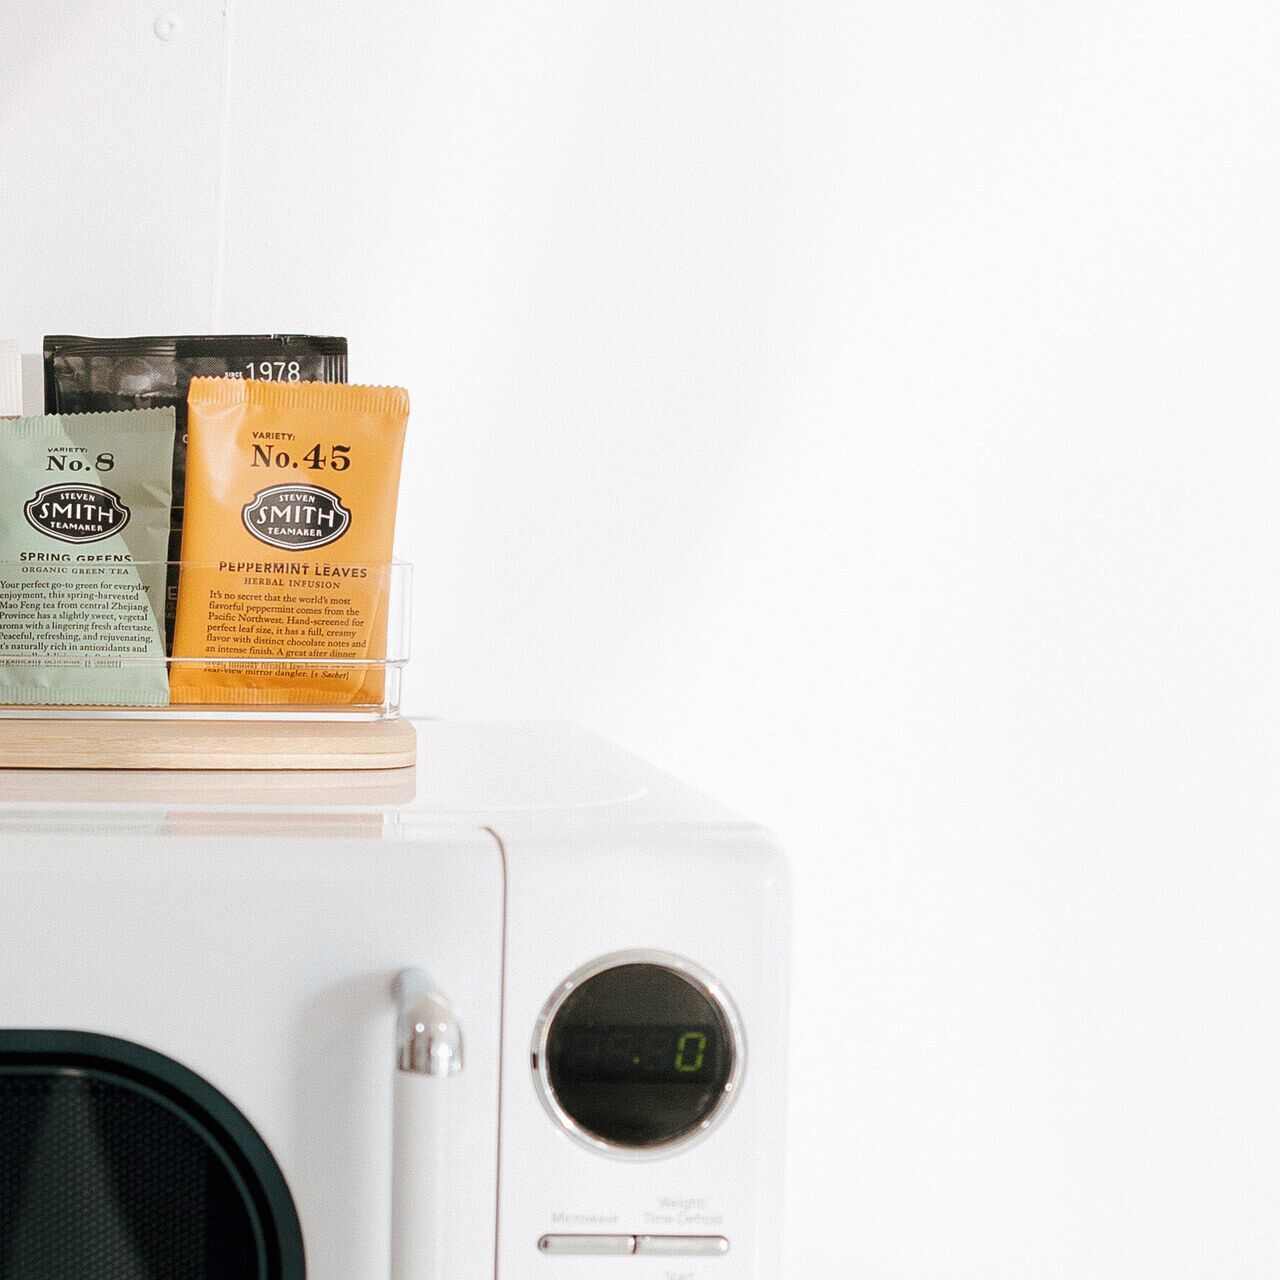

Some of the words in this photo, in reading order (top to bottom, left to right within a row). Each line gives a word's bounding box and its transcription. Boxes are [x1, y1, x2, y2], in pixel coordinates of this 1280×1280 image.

[246, 361, 300, 382] 1978
[252, 432, 295, 440] VARIETY:
[60, 492, 96, 502] STEVEN
[278, 494, 316, 504] STEVEN
[39, 502, 114, 524] SMITH
[256, 504, 335, 528] SMITH
[50, 521, 103, 532] TEAMAKER
[267, 527, 322, 537] TEAMAKER
[20, 552, 71, 562] SPRING
[76, 554, 132, 562] GREENS
[22, 566, 68, 574] ORGANIC
[219, 561, 310, 576] PEPPERMINT
[314, 566, 368, 578] LEAVES
[0, 580, 20, 589] Your
[21, 580, 50, 590] perfect
[51, 582, 74, 590] go-to
[75, 582, 98, 590] green
[100, 581, 112, 589] for
[114, 582, 150, 593] everyday
[244, 578, 285, 586] HERBAL
[288, 580, 341, 589] INFUSION
[0, 592, 46, 600] enjoyment,
[66, 592, 139, 600] spring-harvested
[210, 590, 222, 598] It's
[264, 593, 280, 602] that
[284, 594, 296, 602] the
[298, 596, 328, 604] world's
[20, 602, 40, 610] Feng
[57, 600, 78, 609] from
[80, 602, 109, 610] central
[111, 602, 149, 612] Zhejiang
[208, 600, 244, 610] flavorful
[246, 604, 294, 614] peppermint
[324, 606, 344, 616] from
[346, 608, 360, 616] the
[58, 612, 90, 622] slightly
[118, 614, 148, 622] vegetal
[208, 612, 236, 620] Pacific
[238, 614, 284, 624] Northwest.
[287, 616, 350, 626] Hand-screened
[352, 618, 364, 626] for
[26, 622, 44, 630] with
[52, 622, 90, 632] lingering
[92, 622, 112, 630] fresh
[114, 622, 154, 632] aftertaste.
[207, 623, 236, 632] perfect
[238, 624, 254, 633] leaf
[256, 628, 274, 636] size,
[276, 626, 284, 635] it
[284, 626, 299, 636] has
[308, 628, 324, 637] full,
[326, 630, 357, 640] creamy
[36, 632, 80, 642] refreshing,
[100, 633, 153, 644] rejuvenating,
[206, 633, 230, 642] flavor
[232, 636, 252, 644] with
[253, 636, 284, 646] distinct
[286, 638, 326, 647] chocolate
[328, 640, 350, 648] notes
[351, 640, 367, 648] and
[10, 642, 49, 652] naturally
[50, 642, 67, 650] rich
[68, 642, 78, 650] in
[80, 644, 130, 652] antioxidants
[132, 644, 148, 652] and
[218, 644, 248, 654] intense
[249, 646, 274, 656] finish.
[276, 648, 284, 656] A
[286, 650, 308, 658] great
[308, 648, 328, 658] after
[330, 650, 358, 658] dinner
